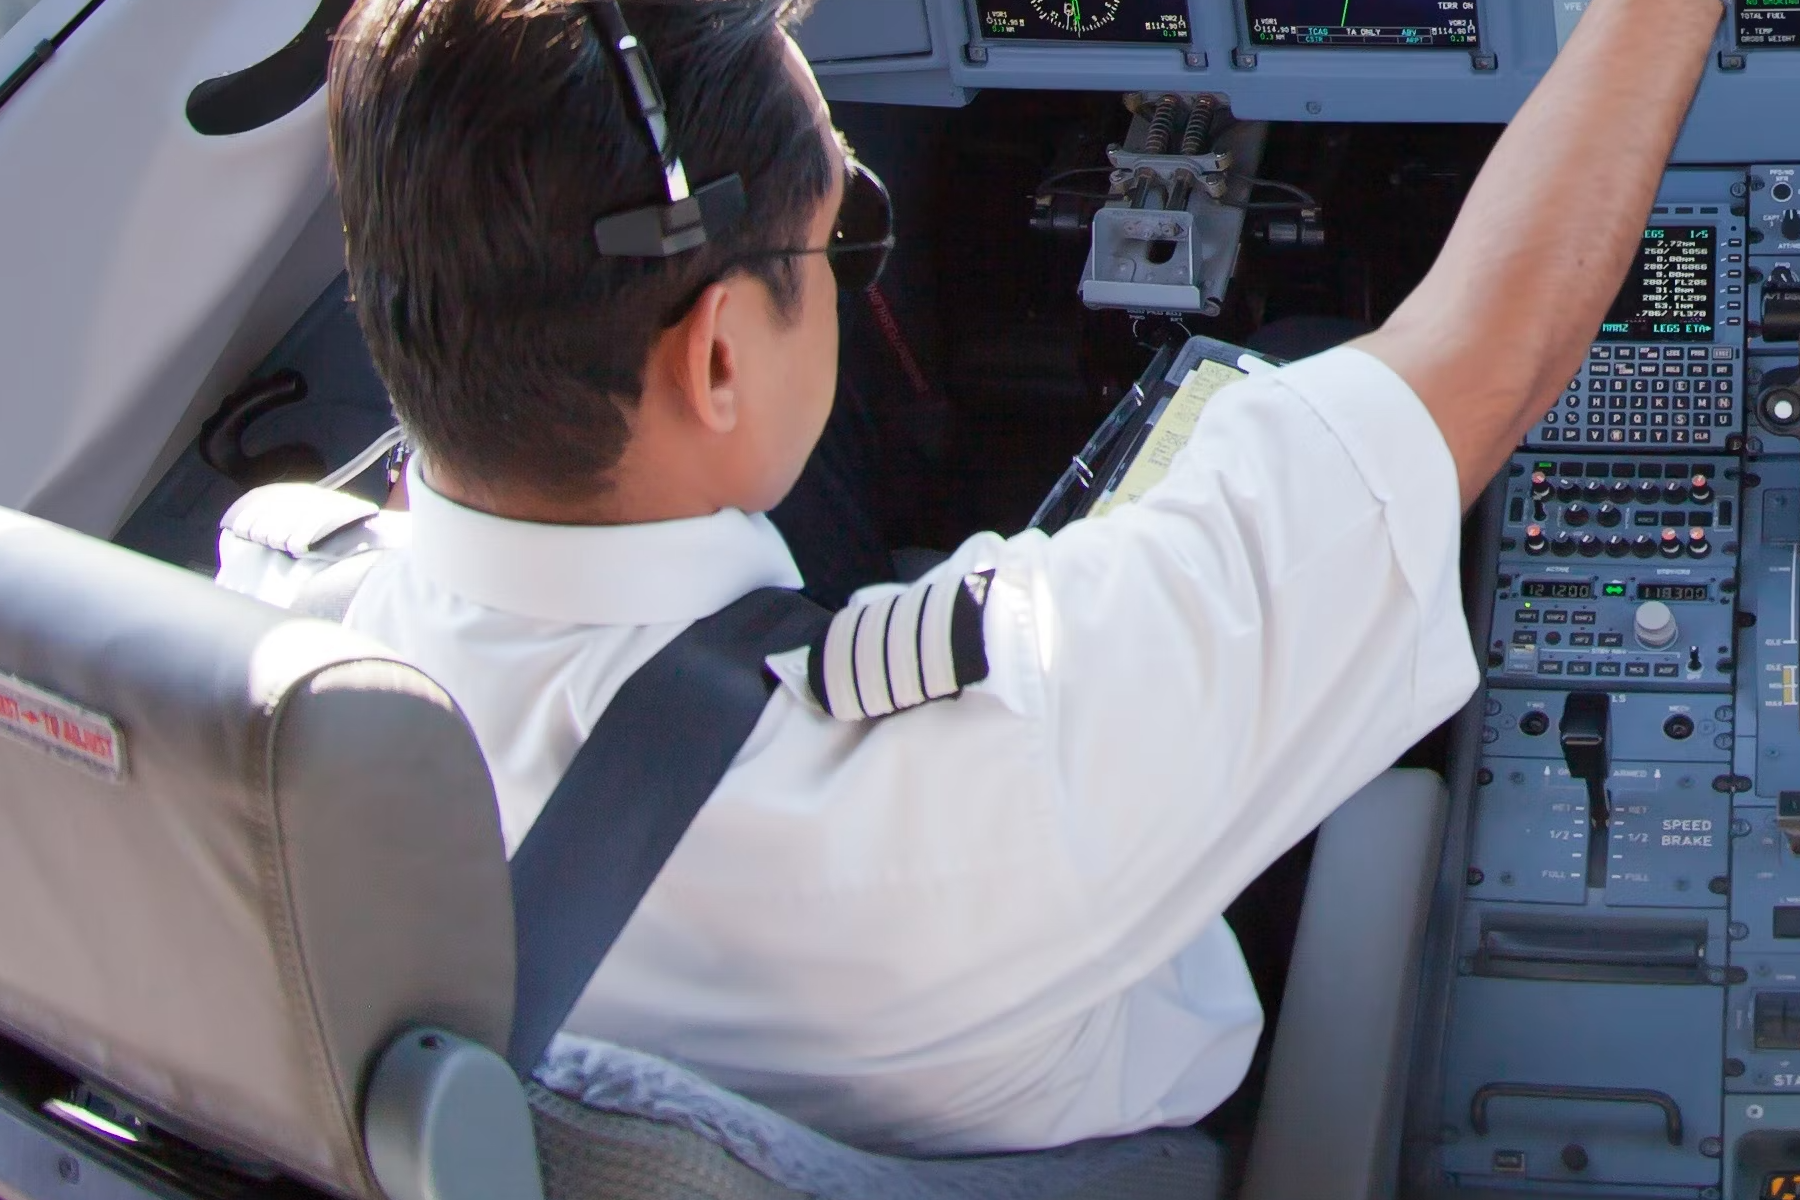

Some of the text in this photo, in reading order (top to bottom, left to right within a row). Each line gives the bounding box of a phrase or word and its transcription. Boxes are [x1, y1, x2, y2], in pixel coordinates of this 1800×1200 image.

[1564, 2, 1582, 10] VFE
[1654, 324, 1680, 332] LEGS
[1662, 820, 1712, 832] SPEED
[1550, 830, 1570, 840] 1/2
[1628, 832, 1649, 842] 1/2
[1662, 835, 1712, 847] BRAKE
